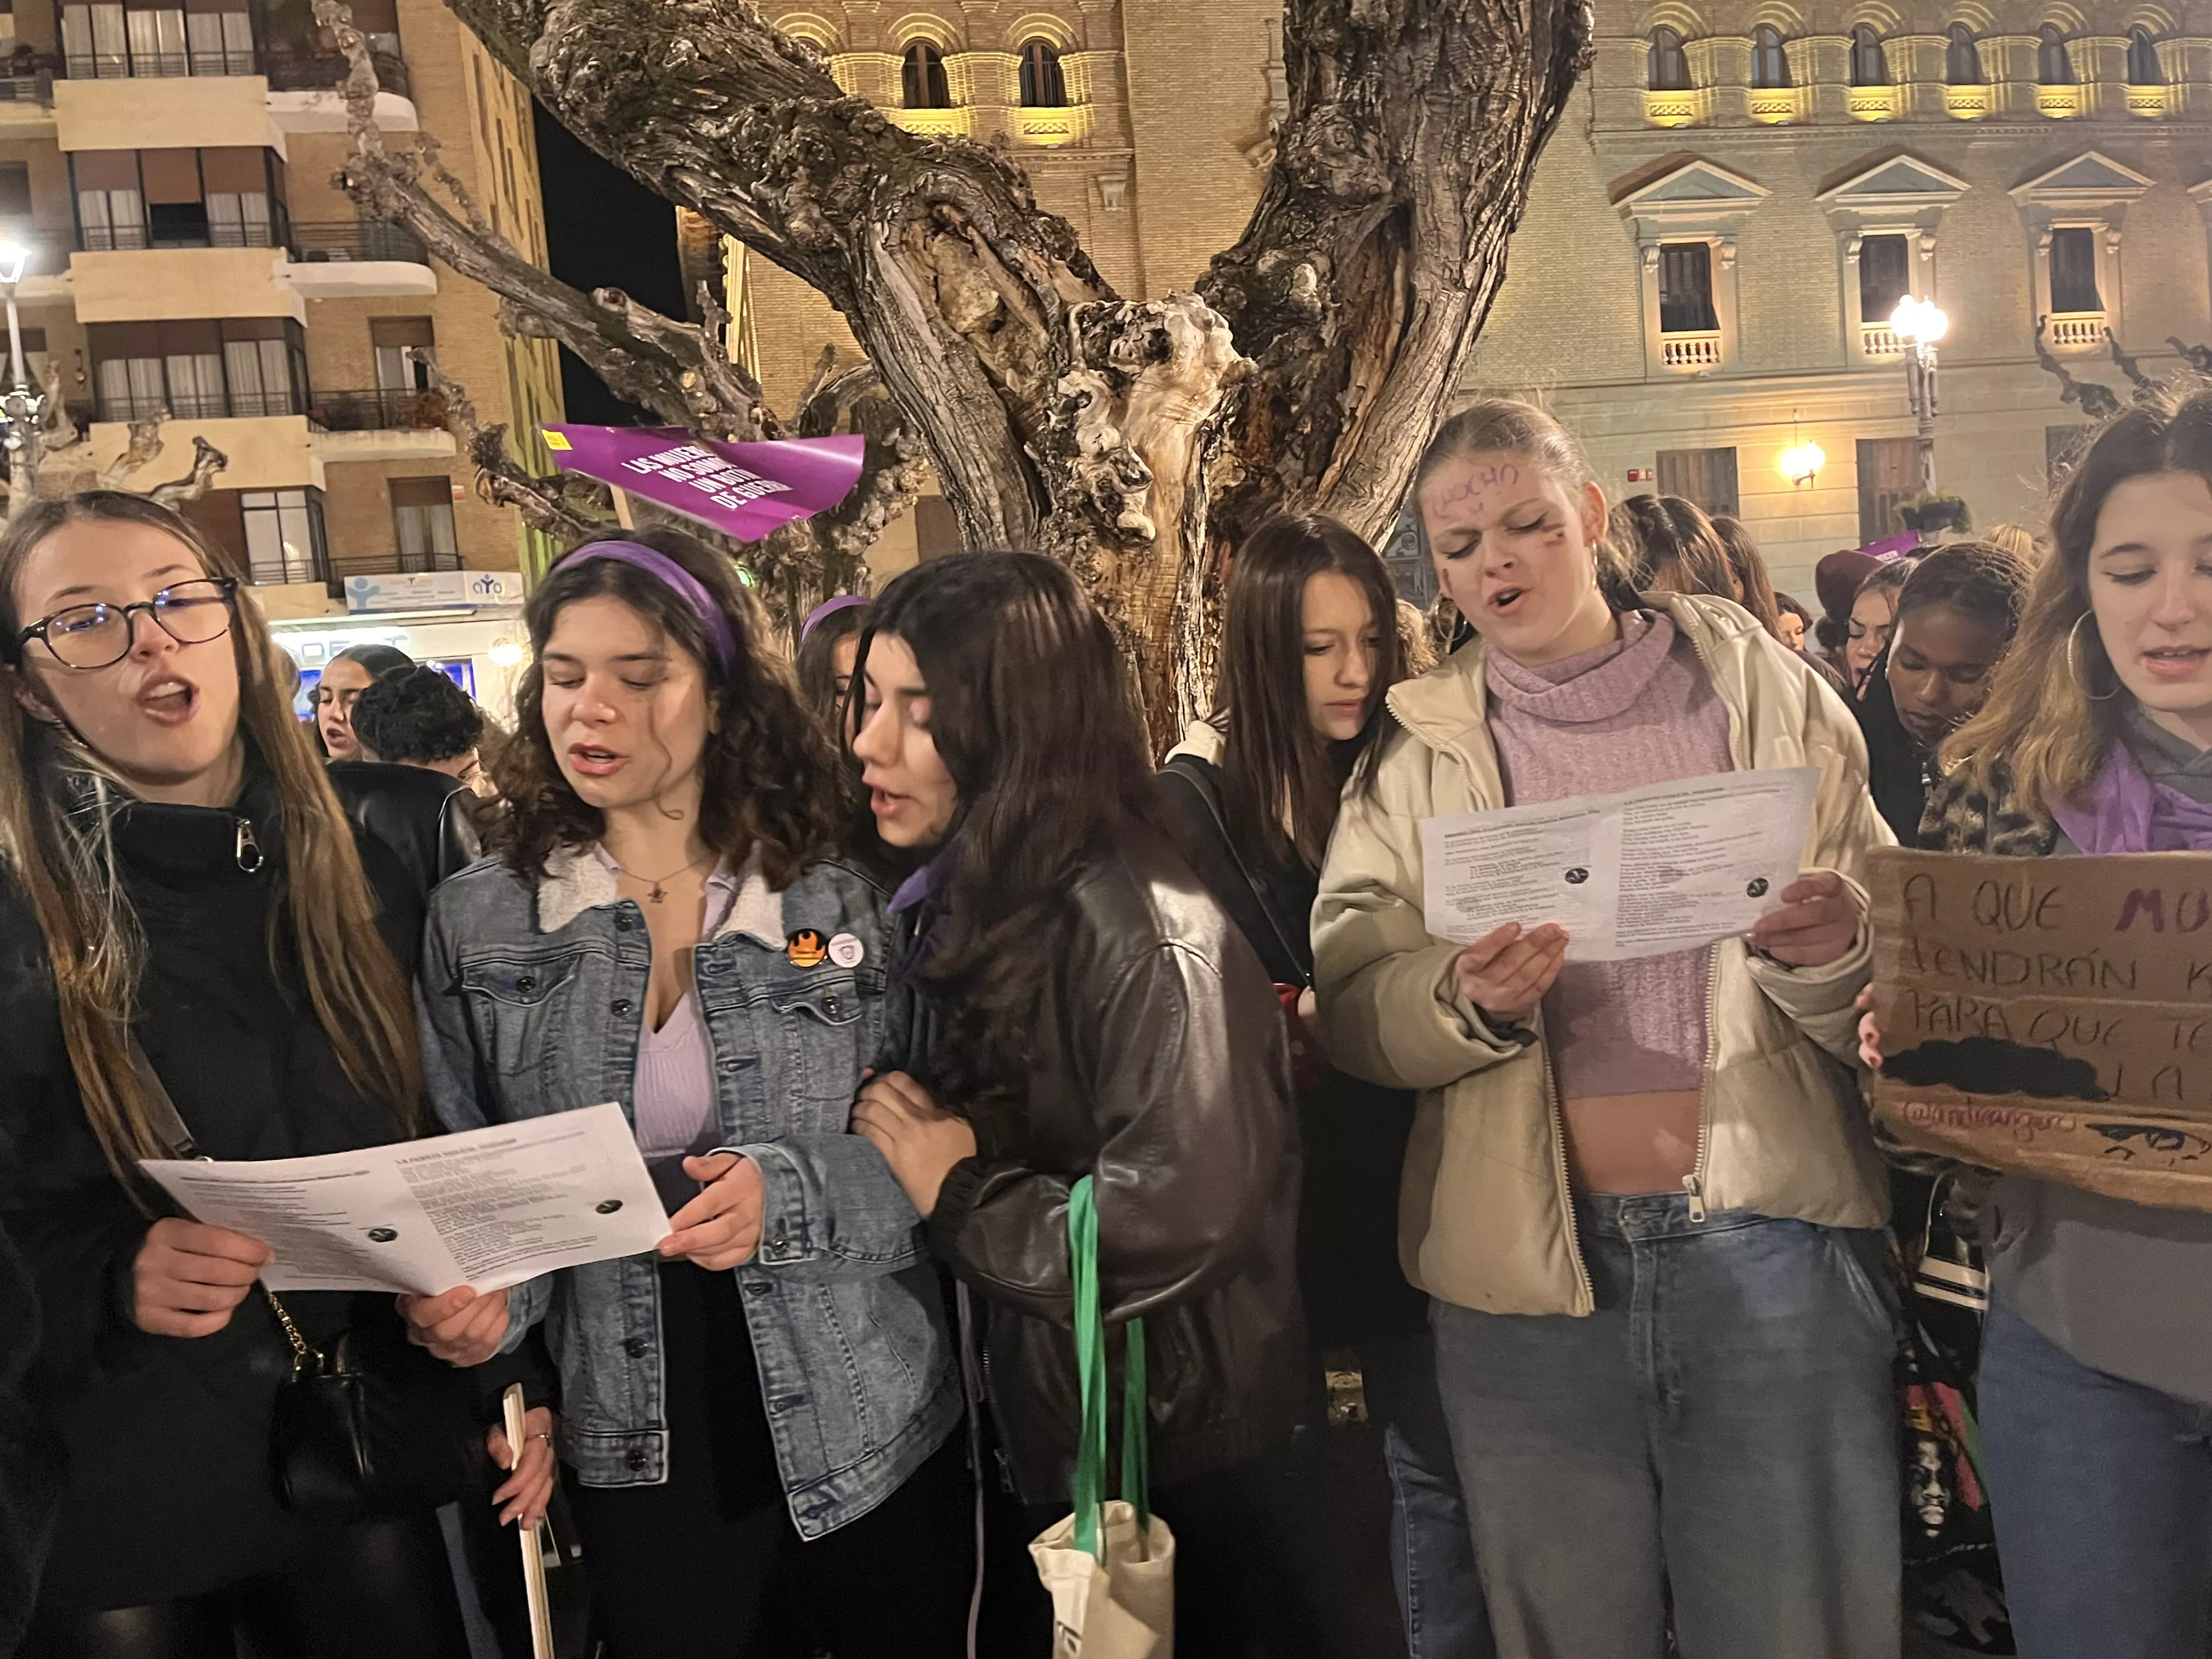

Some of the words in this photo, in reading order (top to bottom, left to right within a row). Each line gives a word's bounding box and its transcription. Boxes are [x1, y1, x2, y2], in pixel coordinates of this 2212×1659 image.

[621, 458, 664, 475] LAS
[658, 467, 695, 483] NO
[688, 474, 726, 493] UN
[710, 491, 748, 510] DE
[1903, 873, 1936, 921] A
[1973, 879, 2063, 932] QUE
[2114, 888, 2210, 933] MU
[1907, 987, 2012, 1040] PARA
[2028, 1008, 2124, 1050] QUE
